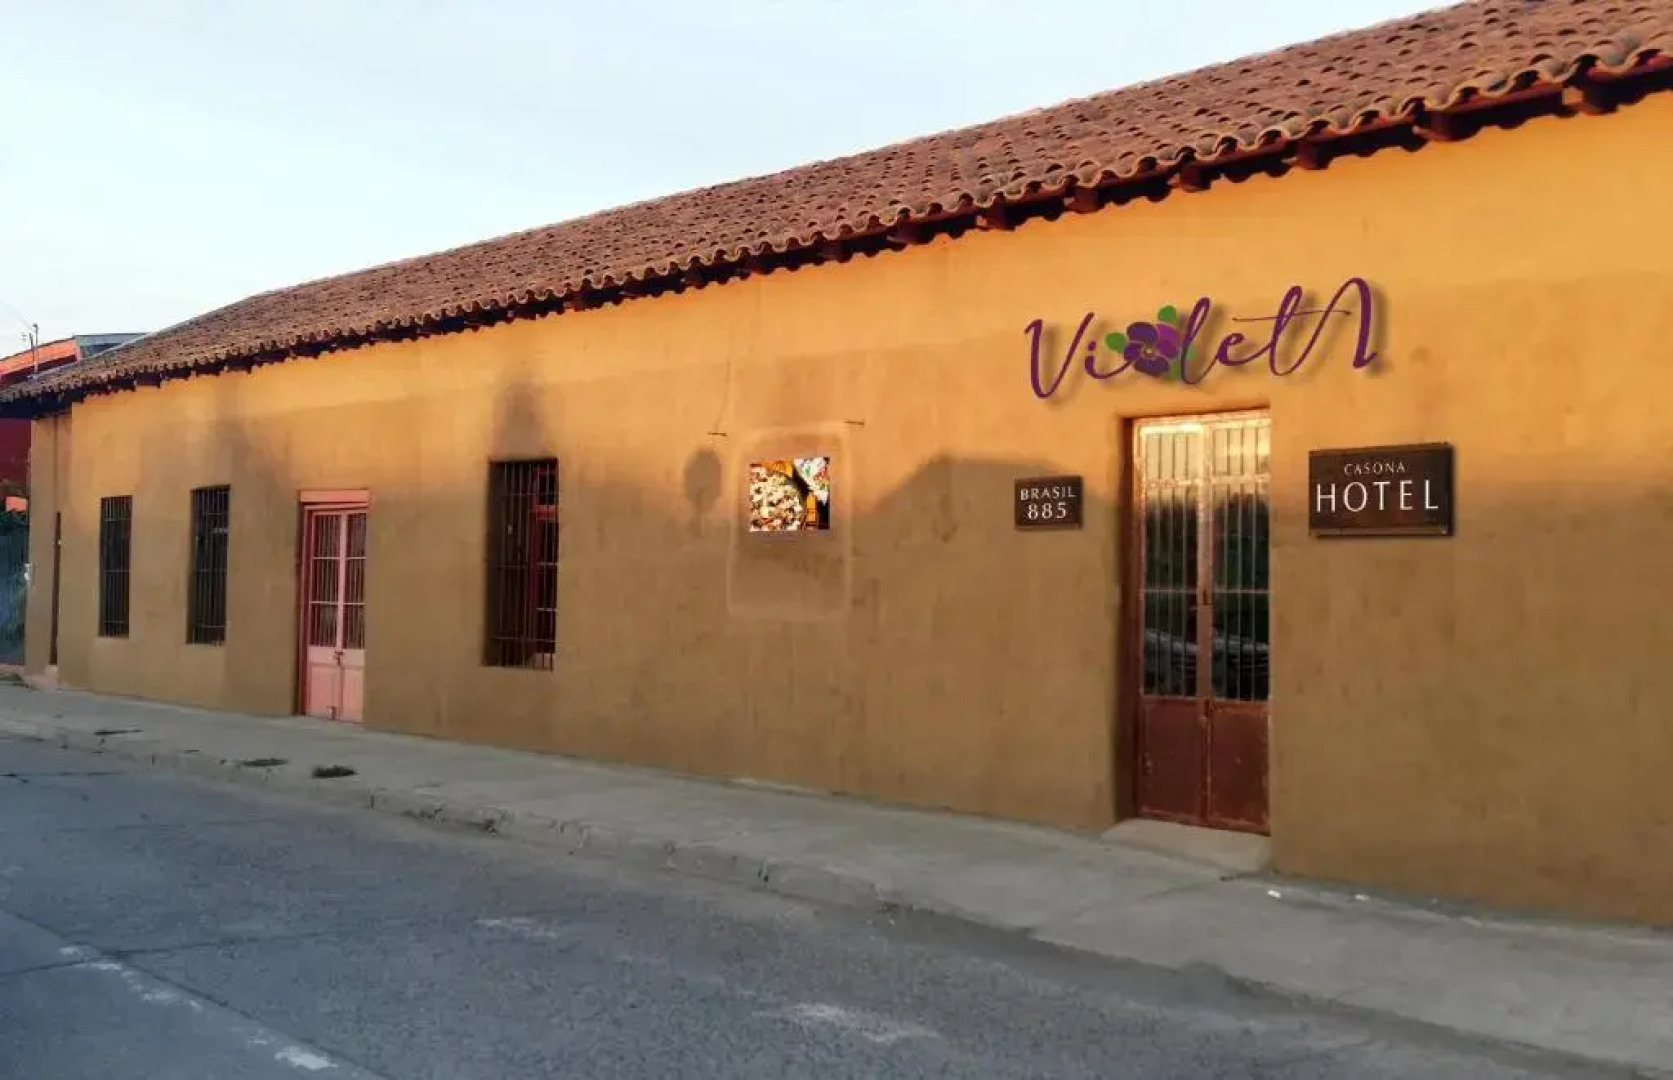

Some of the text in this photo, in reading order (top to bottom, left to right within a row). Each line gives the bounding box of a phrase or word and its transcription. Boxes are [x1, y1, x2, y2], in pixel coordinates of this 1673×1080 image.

[1344, 462, 1406, 475] CASONA
[1020, 486, 1076, 500] BRASIL
[1316, 480, 1439, 512] HOTEL
[1027, 503, 1067, 519] 885
